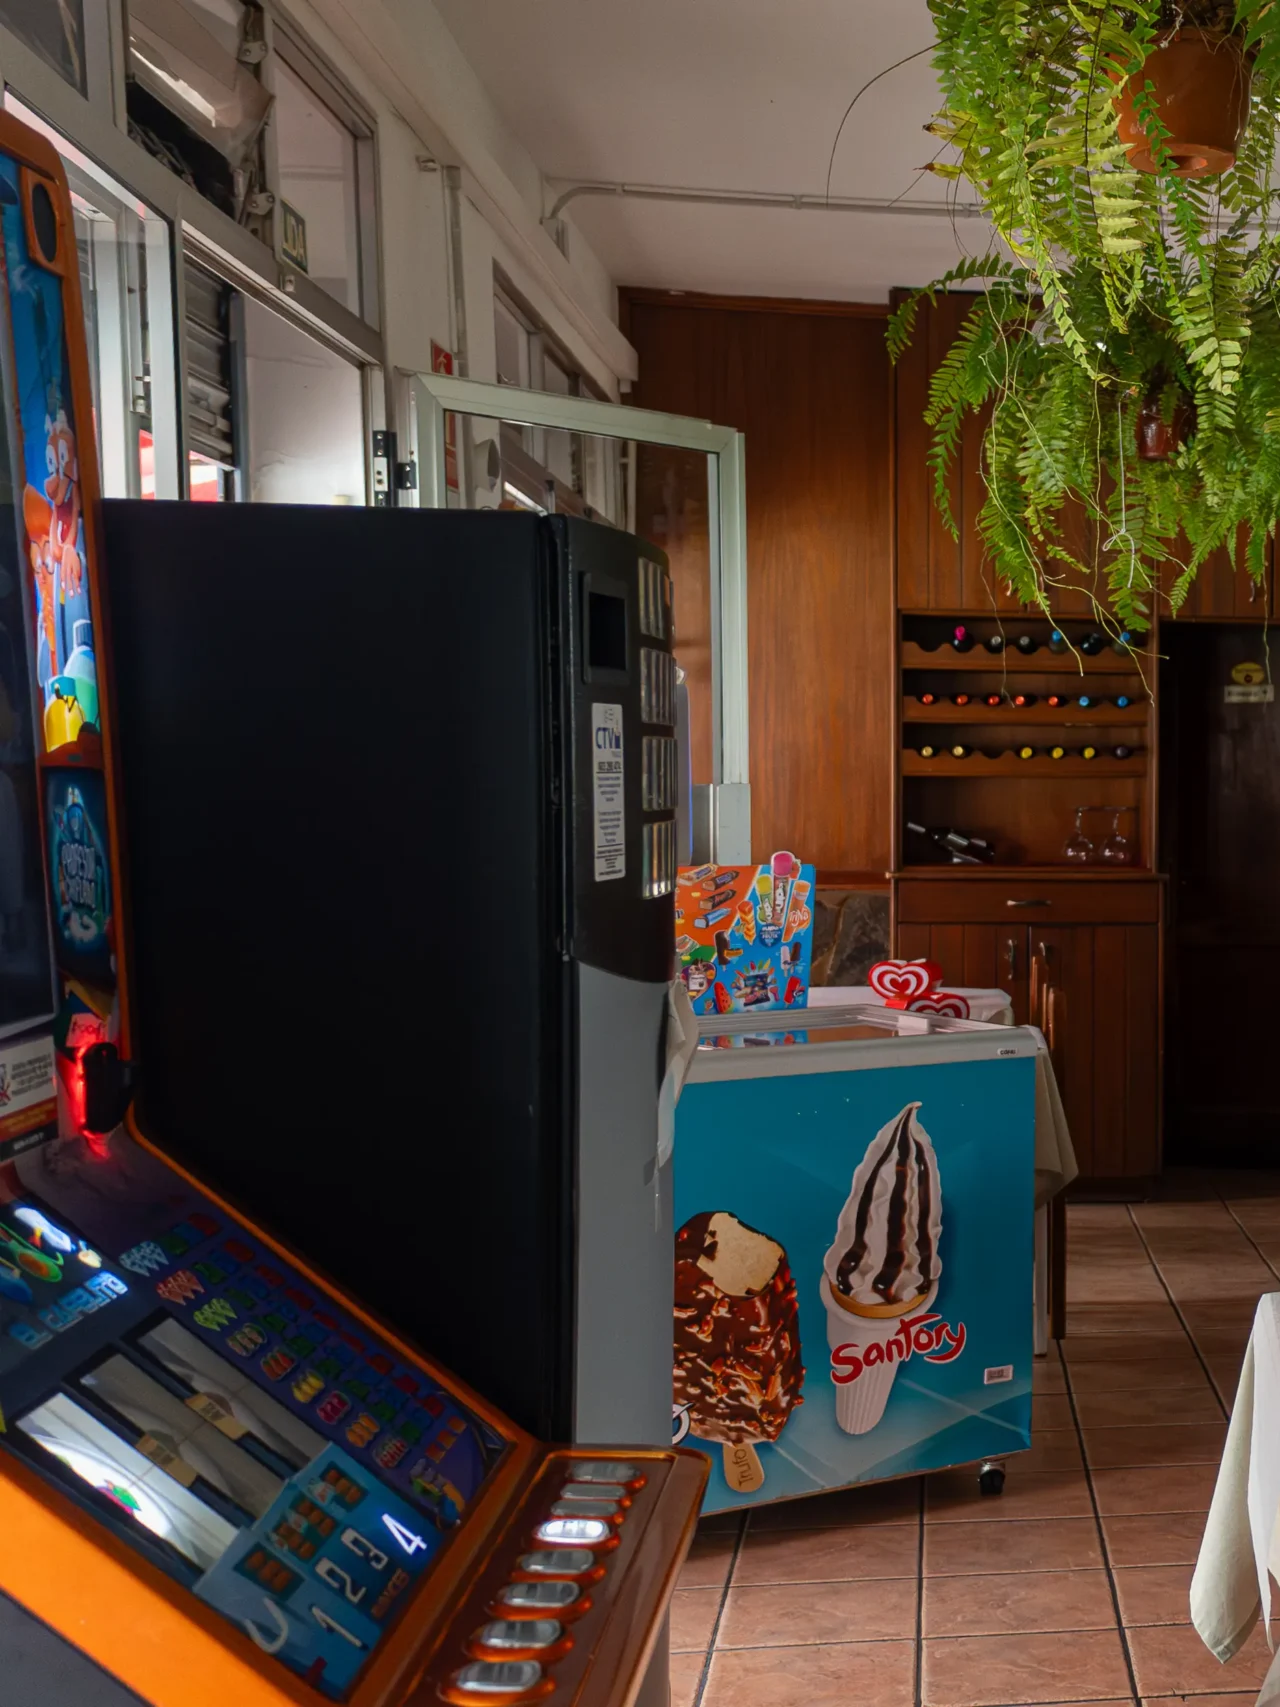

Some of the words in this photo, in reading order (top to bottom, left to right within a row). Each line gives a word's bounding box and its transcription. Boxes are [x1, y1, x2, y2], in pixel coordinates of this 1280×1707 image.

[340, 1527, 389, 1571] 3
[381, 1513, 428, 1556] 4
[314, 1557, 367, 1605] 2
[311, 1604, 363, 1648] 1
